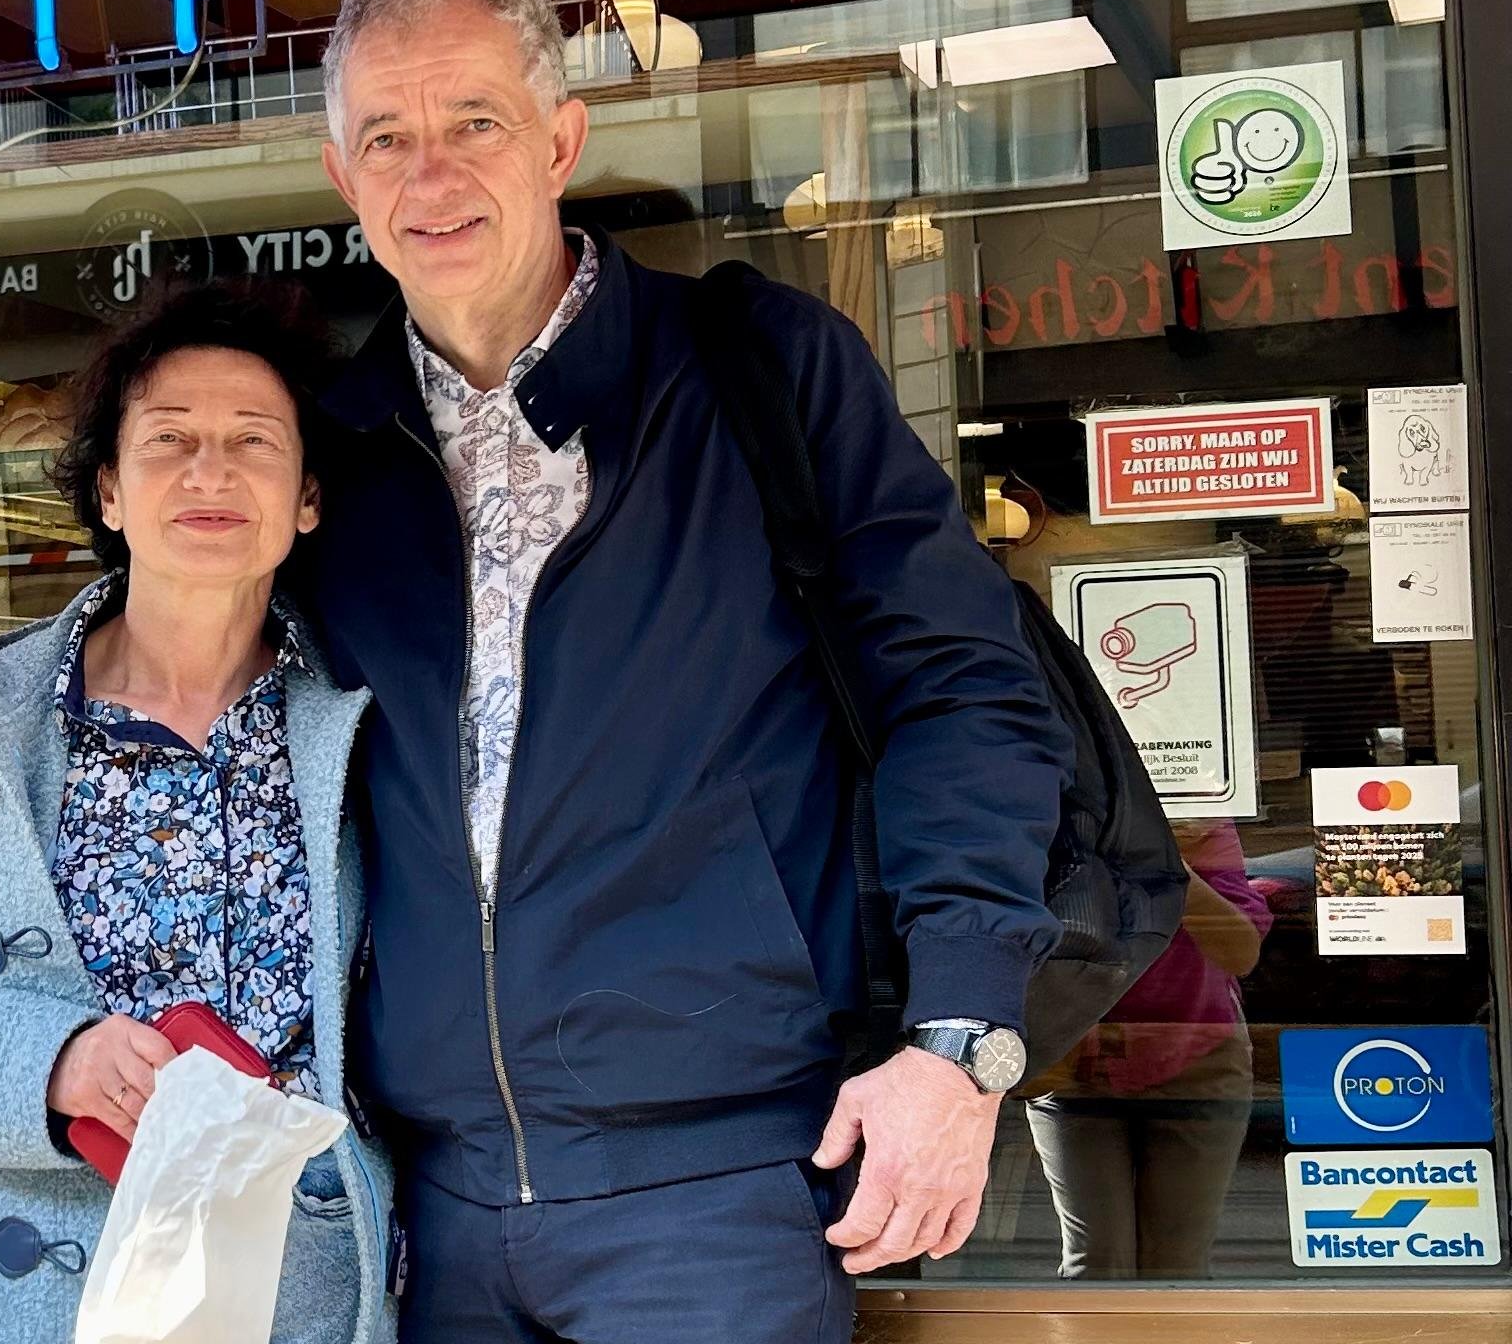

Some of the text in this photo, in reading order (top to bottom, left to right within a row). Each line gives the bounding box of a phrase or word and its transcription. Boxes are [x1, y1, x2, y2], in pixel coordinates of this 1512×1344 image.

[1130, 428, 1288, 454] SORRY, MAAR OP
[1121, 449, 1299, 475] ZATERDAG ZIJN WIJ
[1131, 471, 1290, 496] ALTIJD GESLOTEN
[1376, 625, 1421, 634] VERBODEN
[1435, 624, 1464, 633] ROKEN
[1163, 753, 1199, 763] Besluit
[1171, 766, 1199, 775] 2008
[1426, 831, 1445, 839] zich
[1343, 1076, 1445, 1096] PROTON
[1300, 1159, 1478, 1186] Bancontact
[1306, 1232, 1485, 1259] Mister Cash
